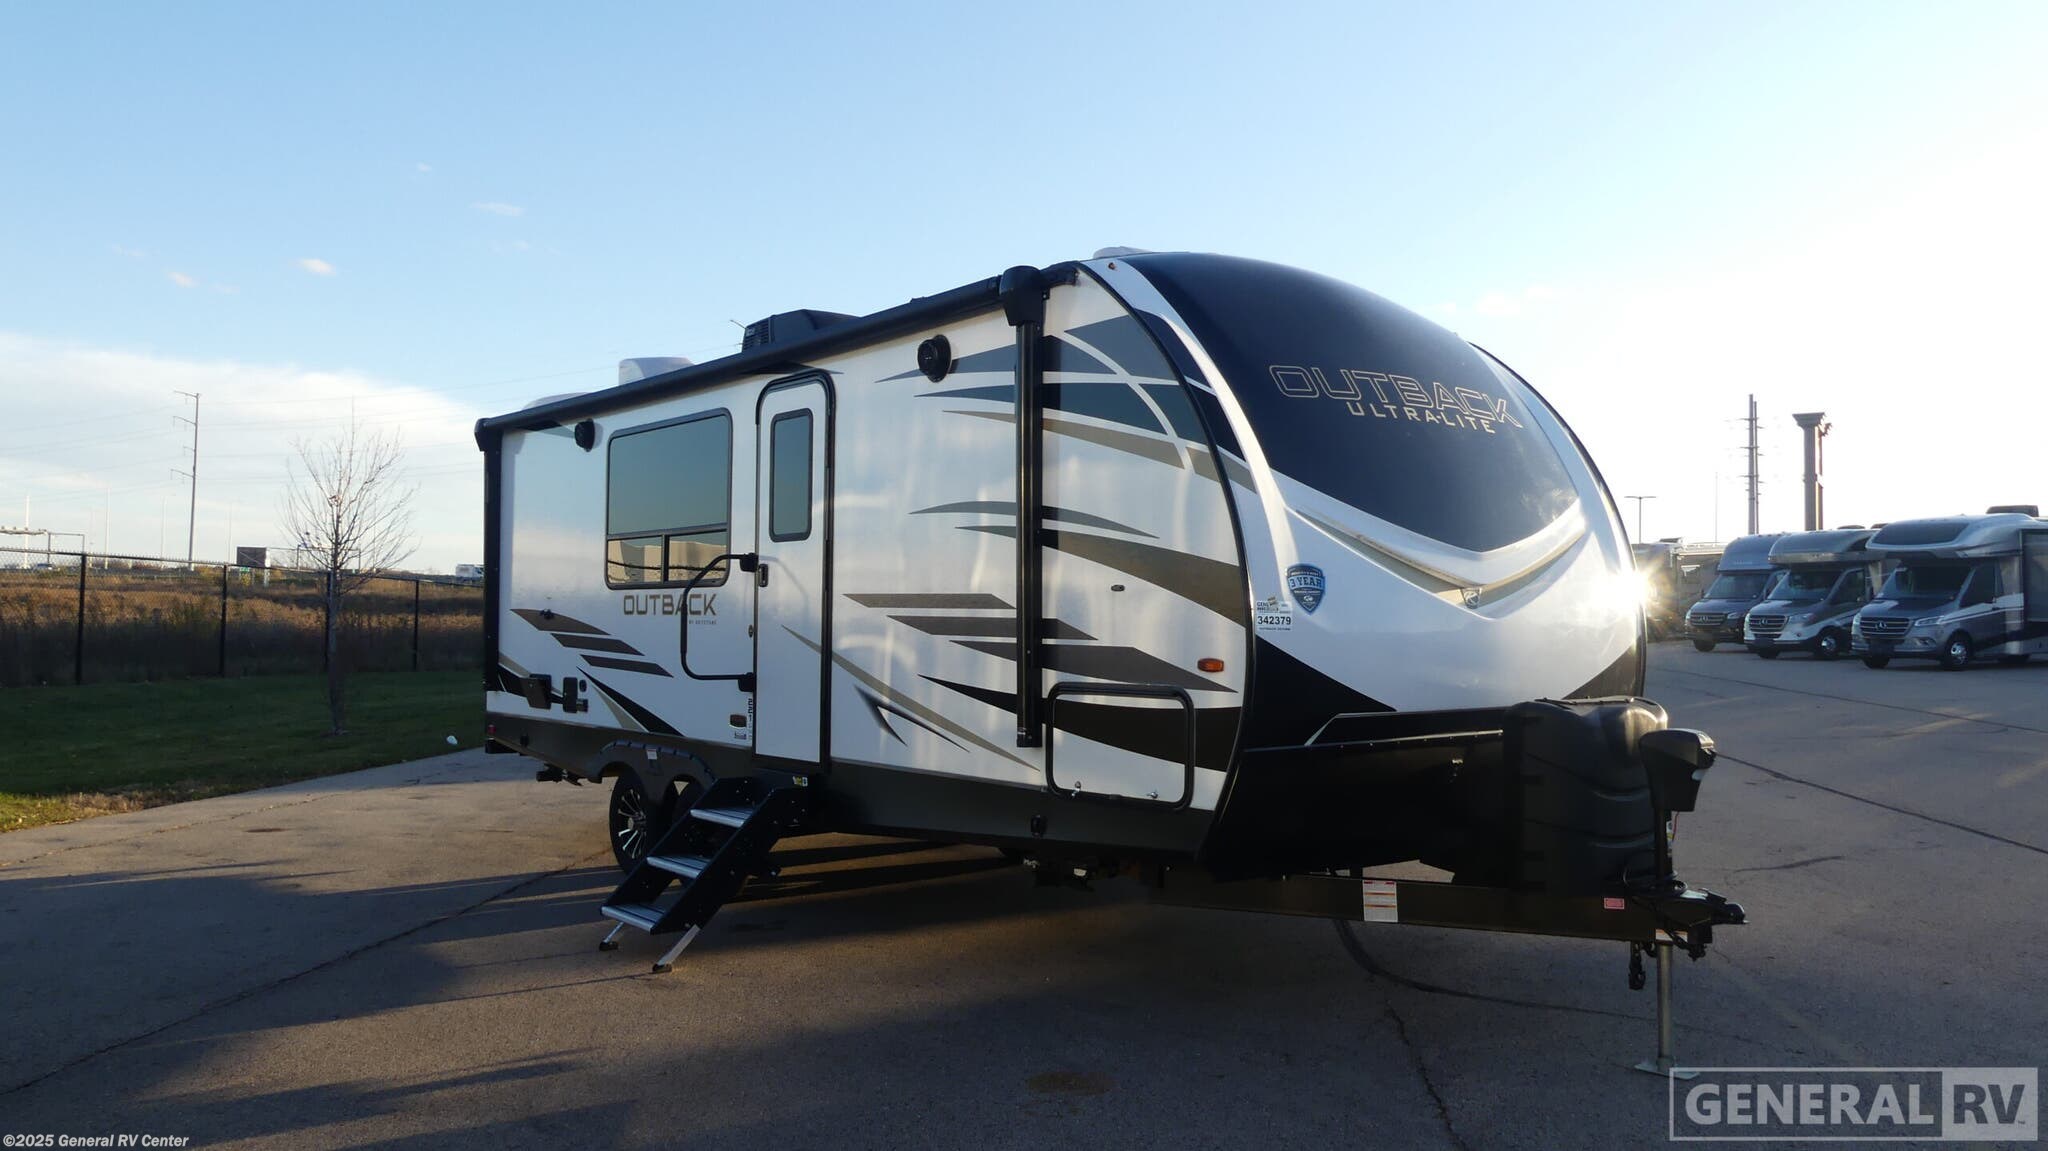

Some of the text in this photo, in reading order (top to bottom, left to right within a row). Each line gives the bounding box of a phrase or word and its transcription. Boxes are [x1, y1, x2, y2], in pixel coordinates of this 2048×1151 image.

[1269, 365, 1524, 429] OUTBACK
[1346, 401, 1496, 434] ULTRA-LITE
[1289, 576, 1323, 588] 3 YEAR
[1257, 615, 1292, 626] 342379
